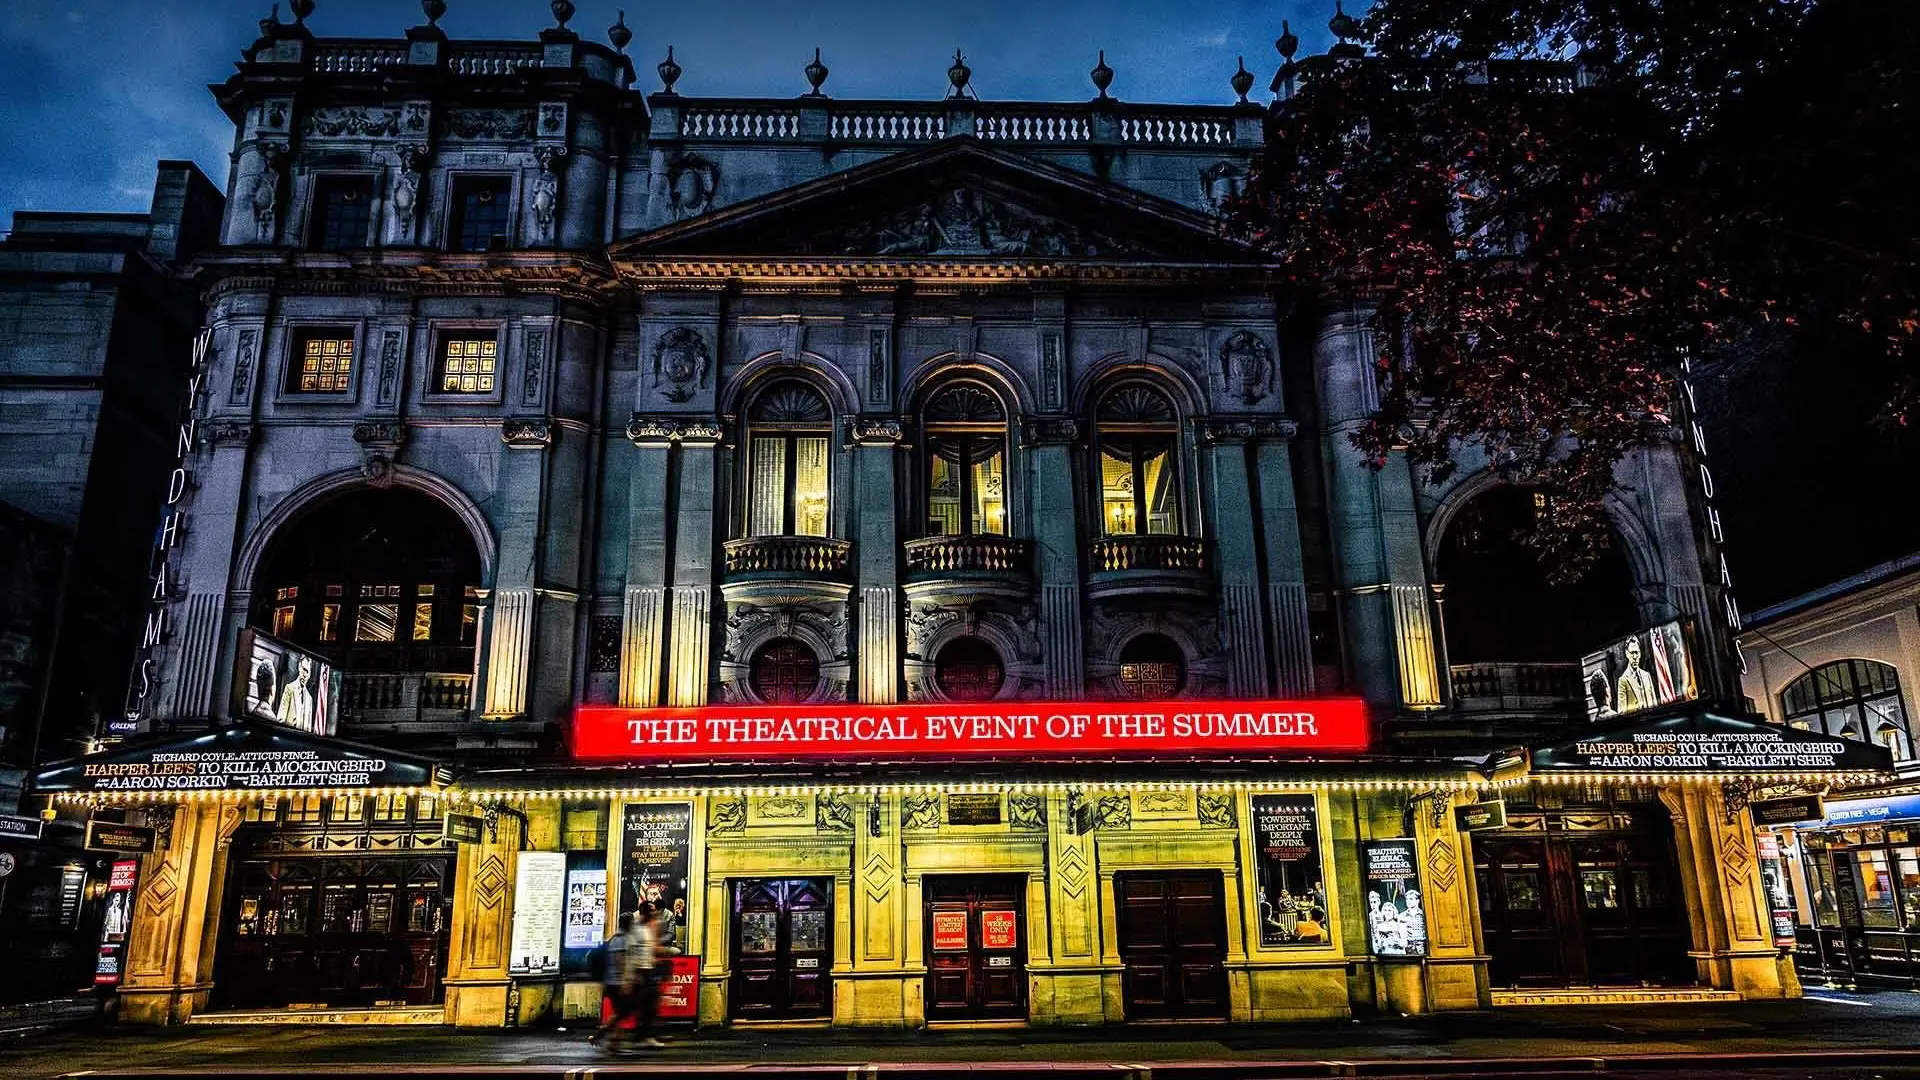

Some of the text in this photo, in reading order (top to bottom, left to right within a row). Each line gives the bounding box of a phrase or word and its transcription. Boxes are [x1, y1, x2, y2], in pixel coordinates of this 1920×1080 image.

[627, 712, 1319, 744] THE THEATRICAL EVENT OF THE SUMMER
[1633, 733, 1677, 742] RICHARD
[1576, 742, 1846, 755] HARPER LEE'S TO KILL A MOCKINGBIRD
[152, 752, 201, 763] RICHARD
[1601, 755, 1653, 767] AARON
[1653, 755, 1709, 767] SORKIN
[1726, 755, 1797, 767] BARTLETT
[1797, 754, 1836, 767] SHER
[84, 759, 386, 776] HARPER LEE'S TO KILL A MOCKINGBIRD
[107, 776, 167, 789] AARON
[166, 775, 229, 788] SORKIN
[248, 773, 329, 786] BARTLETT
[328, 772, 370, 785] SHER
[1868, 806, 1890, 817] VEGAN
[0, 820, 27, 833] STATION
[643, 830, 669, 838] MUST
[1269, 831, 1303, 839] DEEPLY
[636, 838, 649, 846] BE
[649, 838, 676, 846] SEEN
[986, 920, 1012, 928] WEEKS
